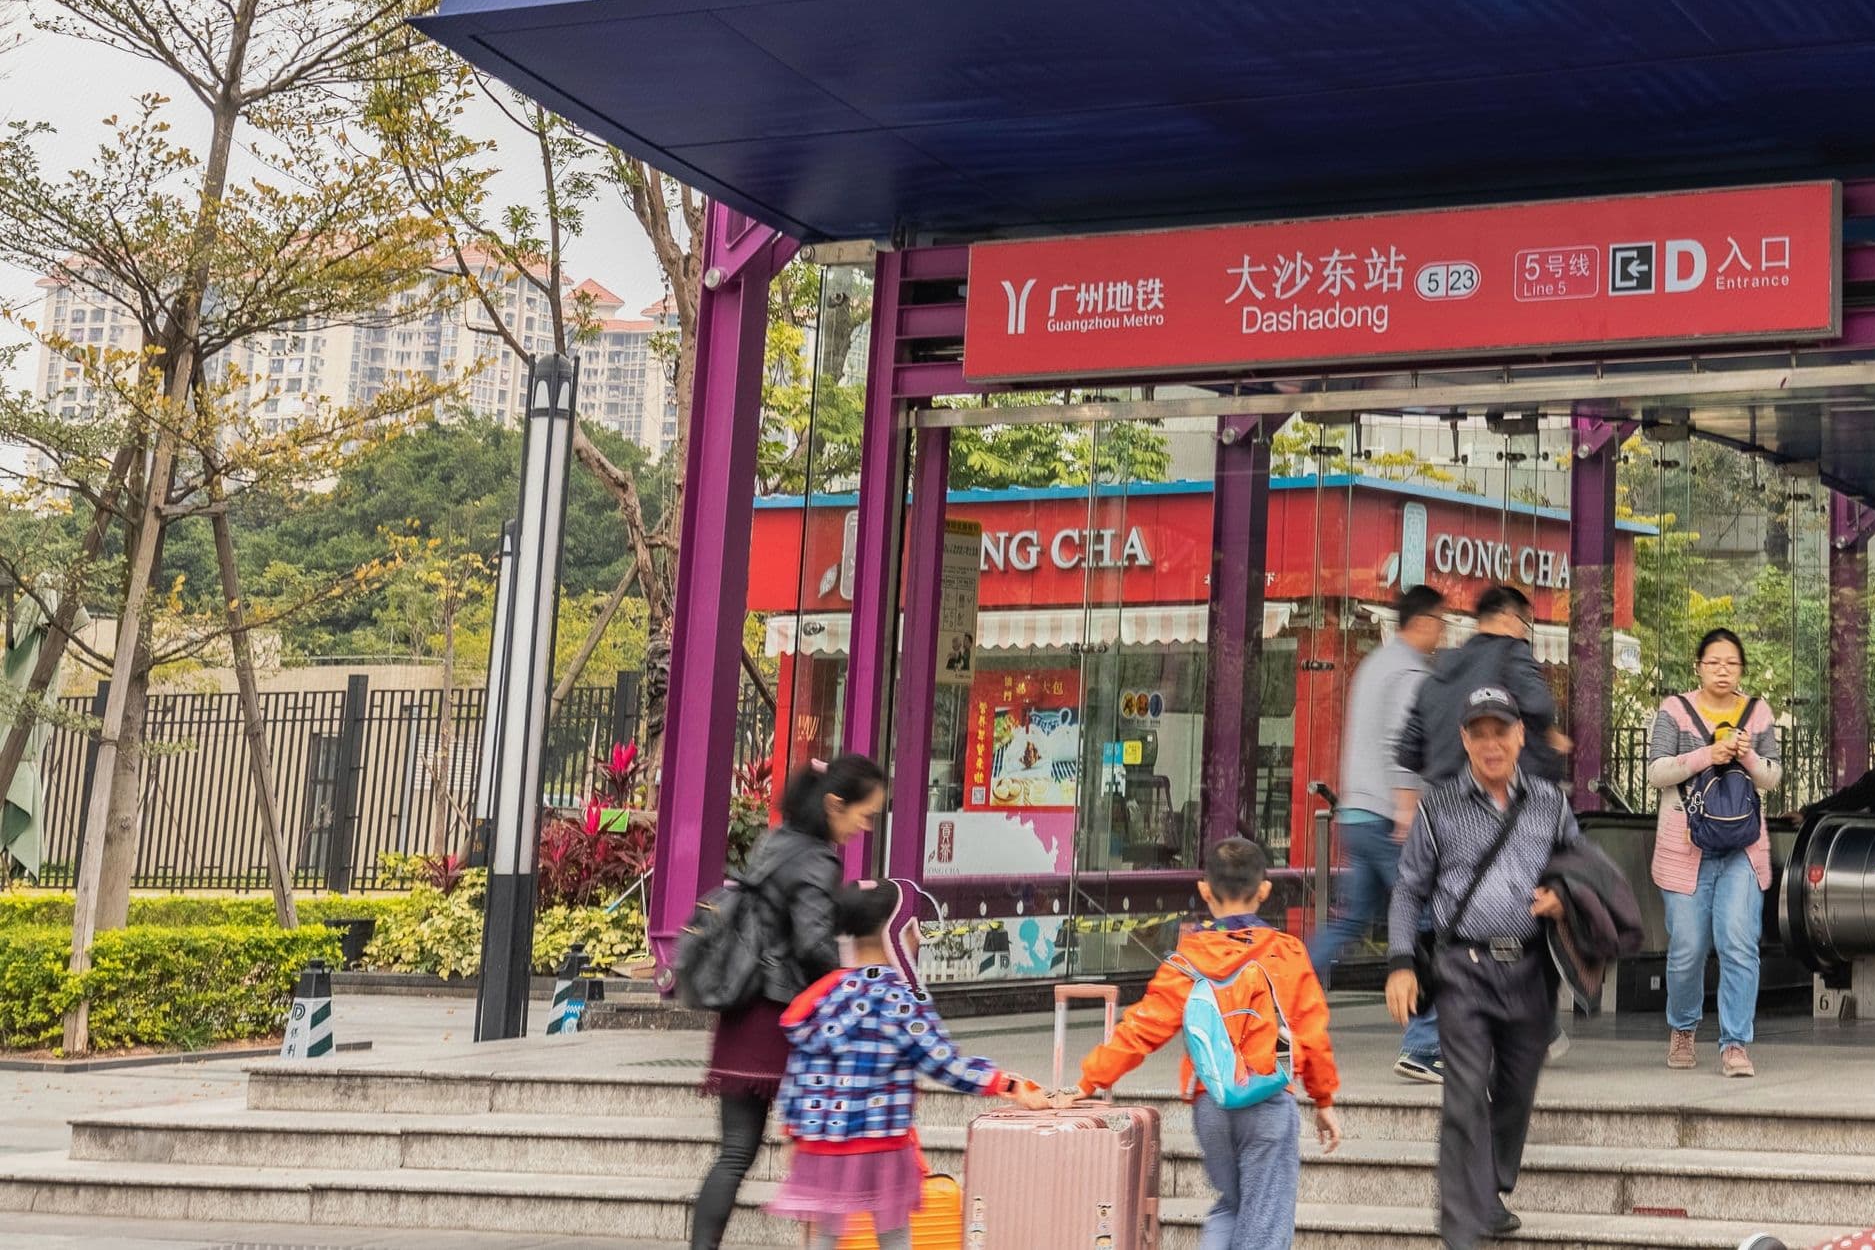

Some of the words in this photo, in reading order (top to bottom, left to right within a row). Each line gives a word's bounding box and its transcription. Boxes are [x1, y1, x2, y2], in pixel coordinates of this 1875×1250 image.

[1524, 253, 1590, 281] 5号线
[1665, 239, 1708, 293] D
[1717, 236, 1790, 273] 入口
[1225, 245, 1407, 304] 大沙东站
[1427, 272, 1440, 293] 5
[1449, 269, 1475, 291] 23
[1523, 283, 1554, 297] Line
[1557, 282, 1567, 295] 5
[1716, 275, 1790, 290] Entrance
[1048, 278, 1164, 317] 广州地铁
[1047, 315, 1120, 333] Guangzhou
[1122, 313, 1164, 328] Metro
[1241, 301, 1389, 334] Dashadong
[980, 530, 1041, 572] NG
[1052, 526, 1152, 569] CHA
[1435, 533, 1512, 582] GONG
[1519, 546, 1570, 590] CHA
[1819, 994, 1829, 1011] 6
